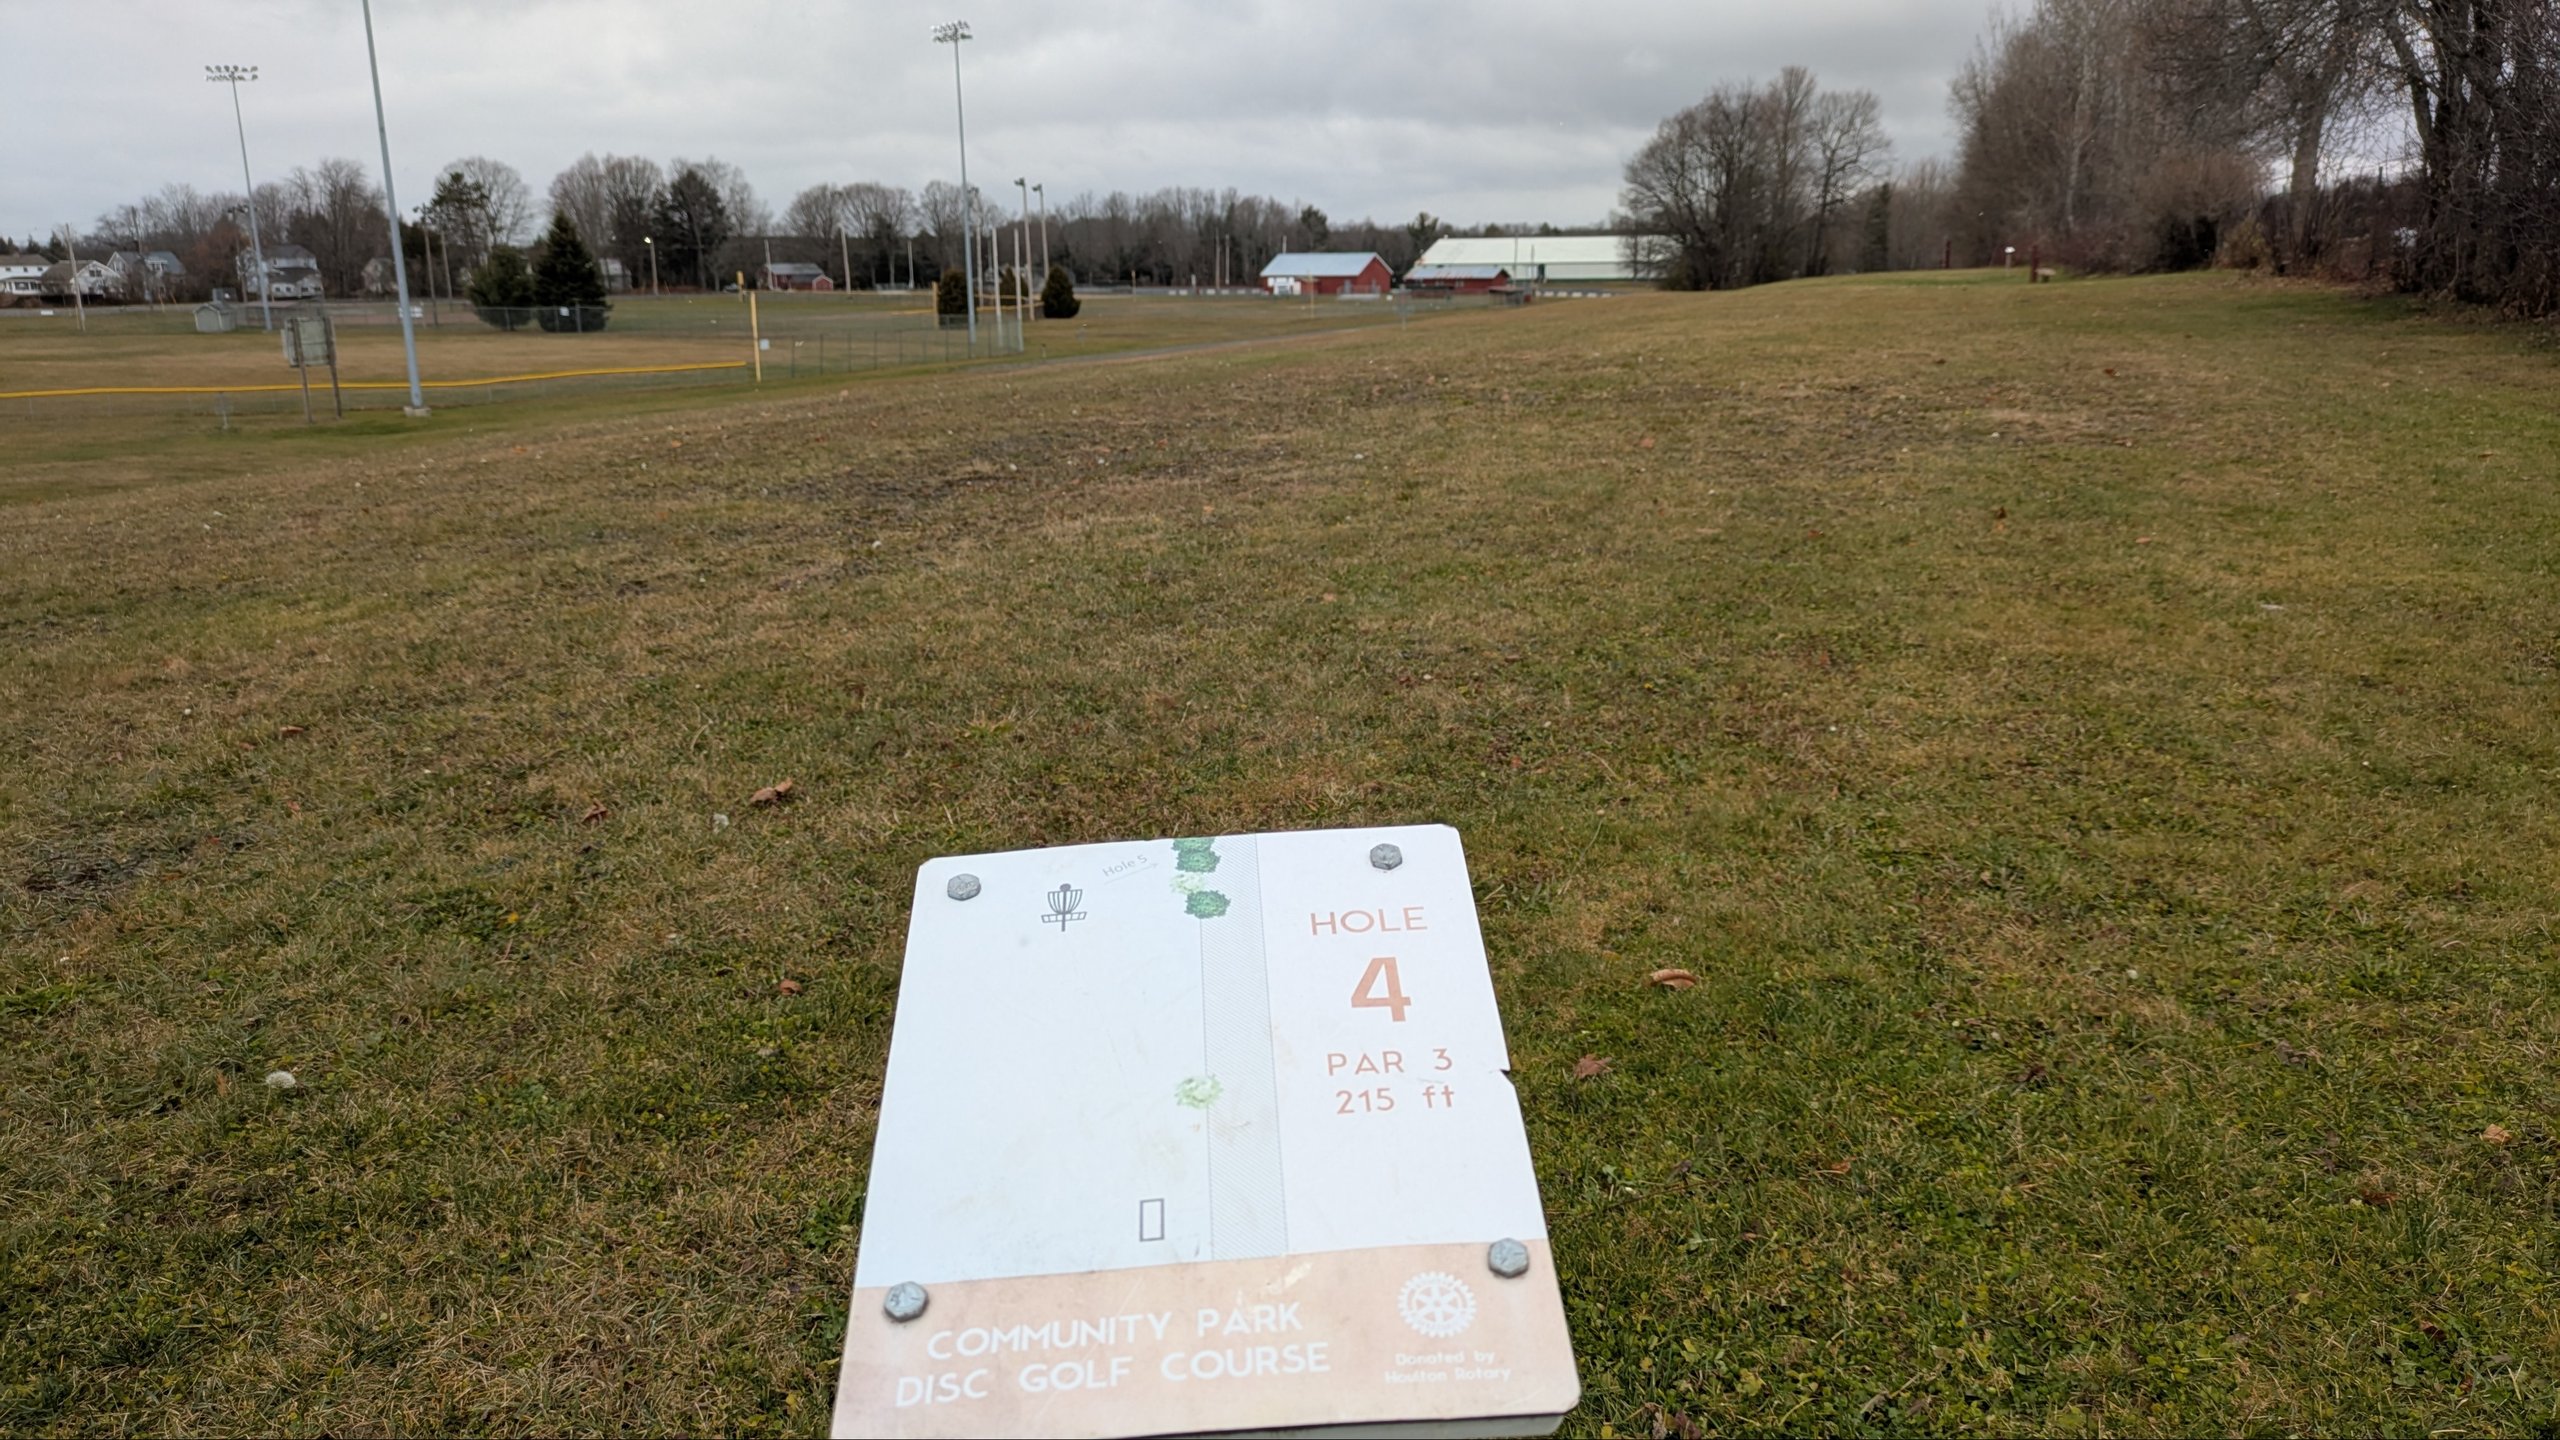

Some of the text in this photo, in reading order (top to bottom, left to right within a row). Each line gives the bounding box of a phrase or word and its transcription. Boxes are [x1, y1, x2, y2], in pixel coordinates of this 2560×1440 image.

[1102, 854, 1148, 877] Hole 5
[1310, 906, 1428, 936] HOLE
[1351, 956, 1412, 1022] 4
[1327, 1048, 1452, 1077] PAR 3
[1335, 1084, 1455, 1115] 215 ft
[927, 1301, 1304, 1360] COMMUNITY PARK
[1394, 1350, 1495, 1366] Donated by
[895, 1341, 1331, 1408] DISC GOLF COURSE
[1454, 1366, 1511, 1383] Rotary
